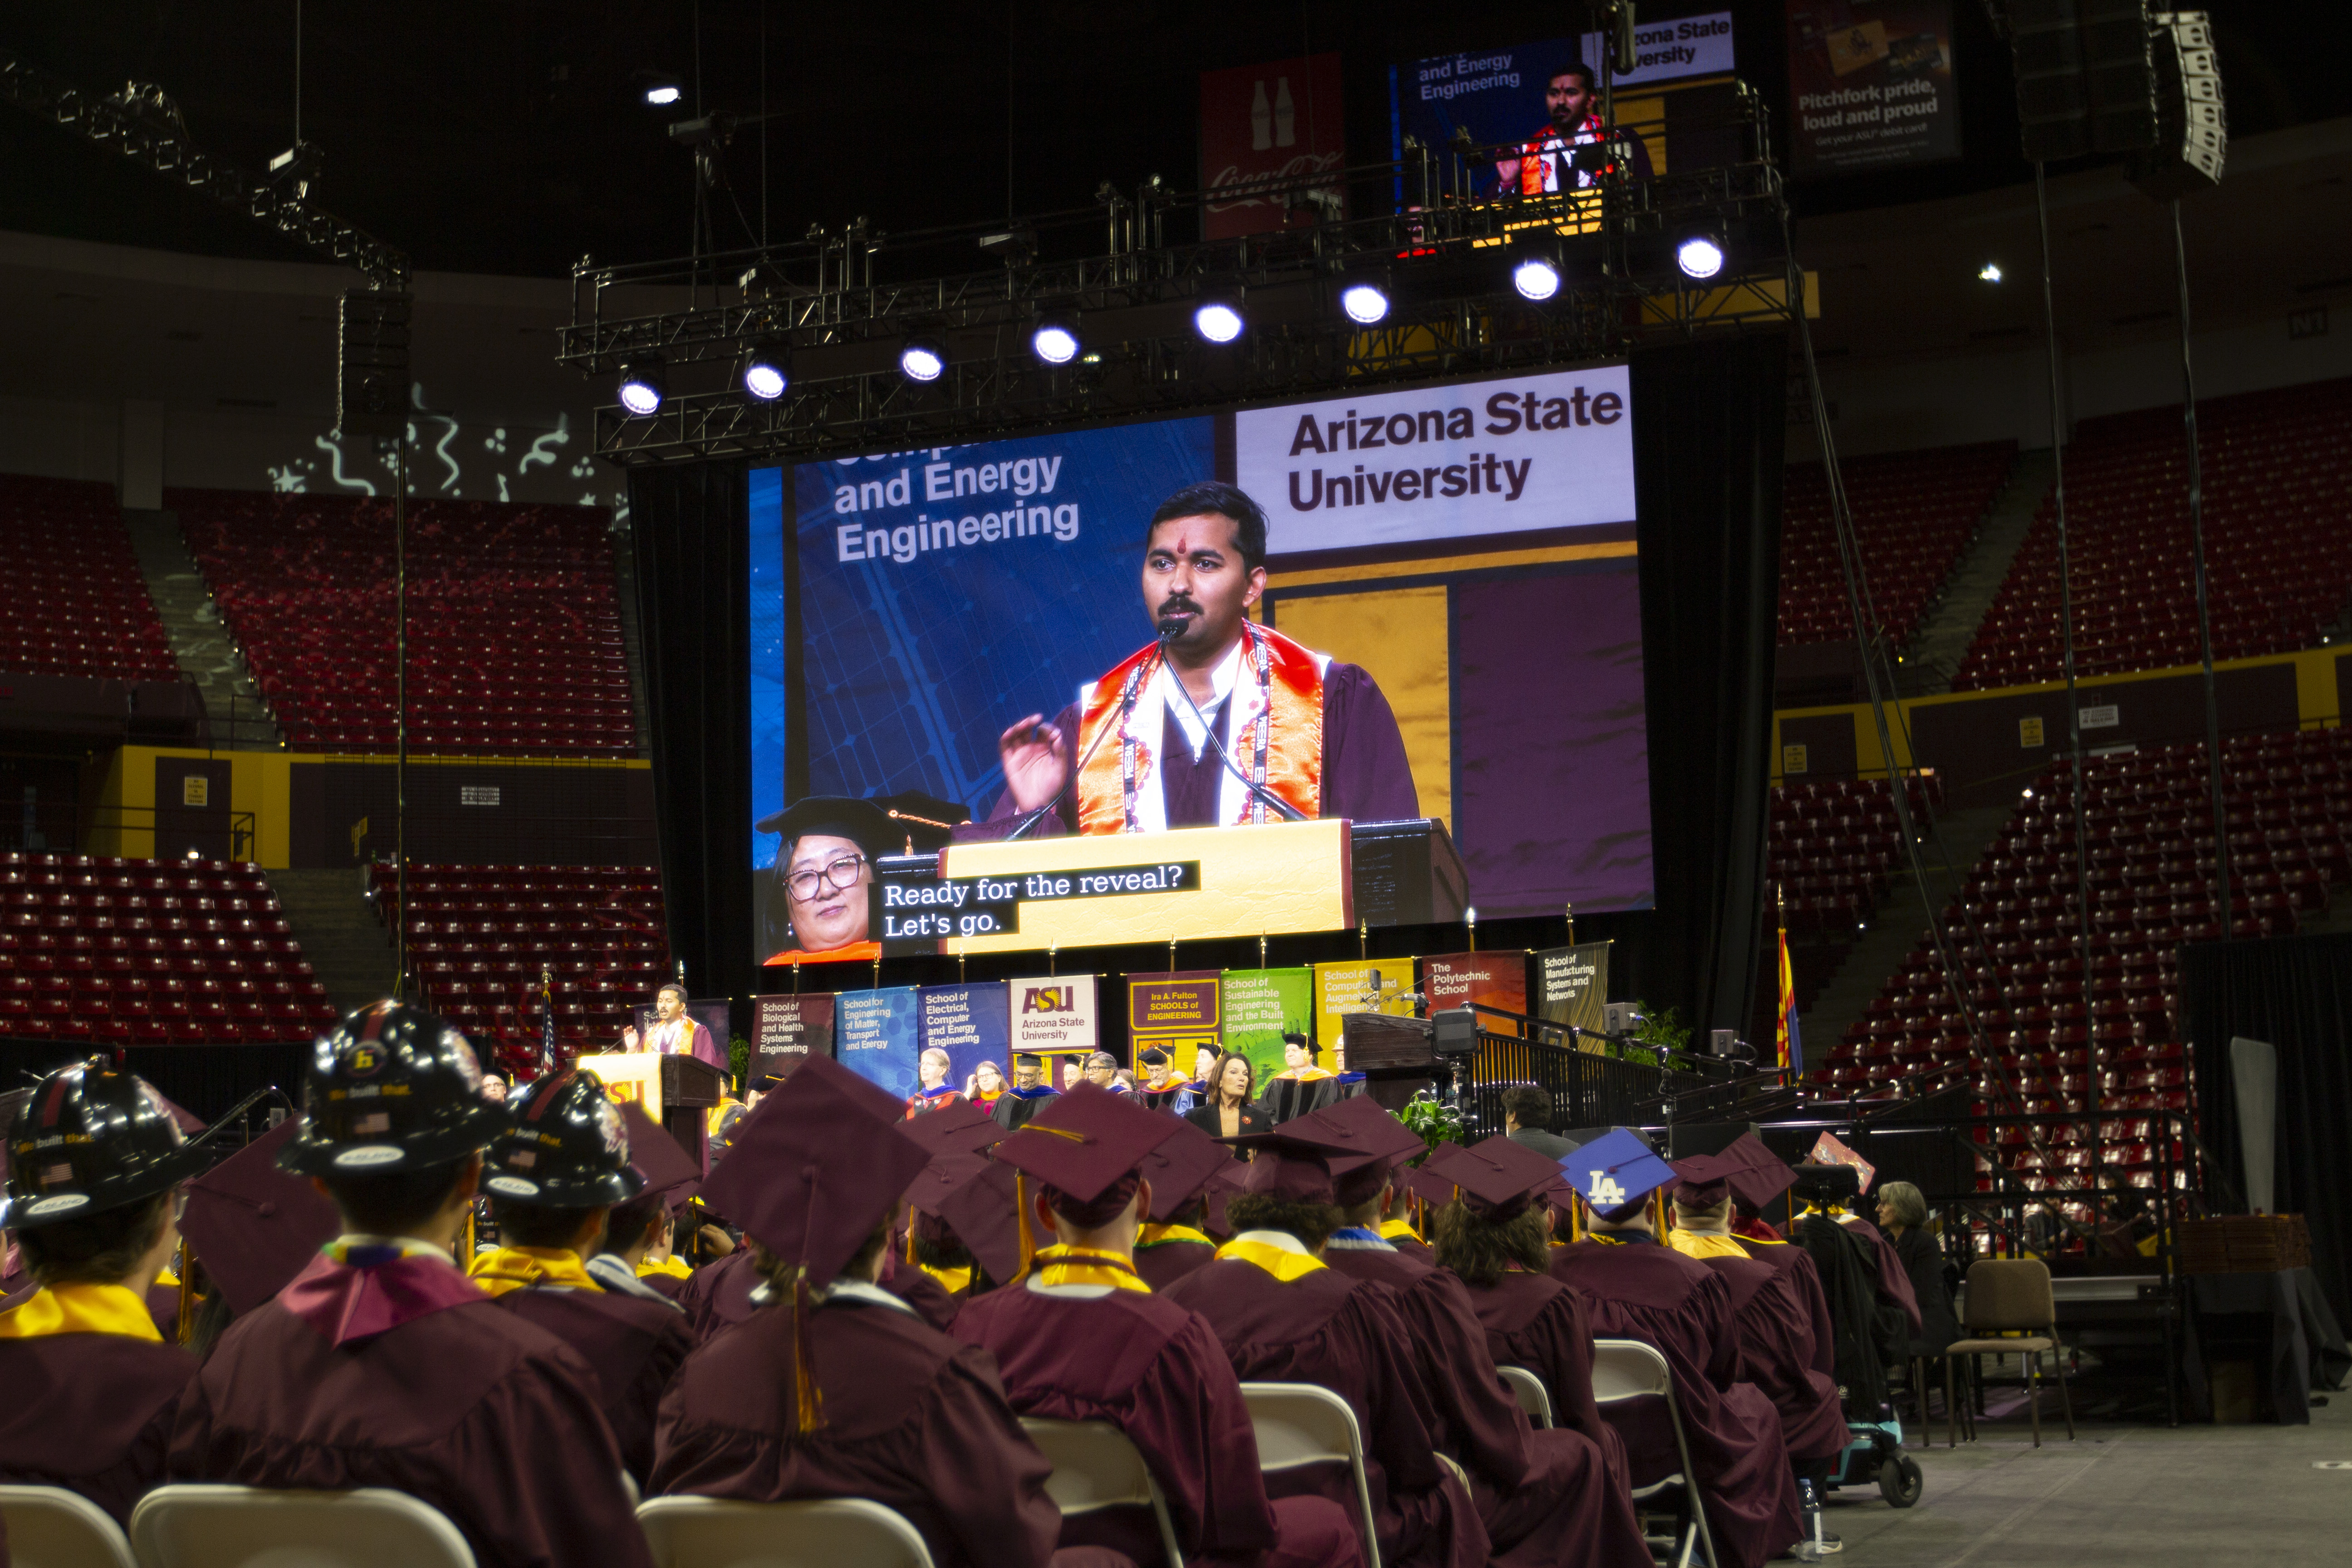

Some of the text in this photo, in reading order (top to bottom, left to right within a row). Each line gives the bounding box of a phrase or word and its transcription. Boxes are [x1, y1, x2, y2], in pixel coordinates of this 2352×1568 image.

[1635, 20, 1730, 46] zona State
[1636, 46, 1695, 68] versity
[1419, 62, 1451, 82] and
[1456, 54, 1513, 74] Energy
[1421, 72, 1520, 100] Engineering
[1798, 78, 1936, 111] Pitchfork pride,
[1803, 97, 1938, 131] loud and proud
[1289, 386, 1623, 456] Arizona State
[834, 456, 1062, 514] and Energy
[1289, 453, 1533, 512] University
[837, 500, 1079, 563] Engineering
[885, 865, 1183, 908] Ready for the reveal?
[885, 913, 1001, 937] Let's go.
[1544, 954, 1577, 968] School of
[1432, 963, 1450, 973] The
[1546, 965, 1595, 979] Manufacturing
[1324, 969, 1368, 980] School of
[1433, 971, 1490, 984] Polytechnic
[1224, 978, 1268, 990] School of
[1434, 983, 1468, 995] School
[1546, 975, 1588, 991] Systems and
[926, 991, 969, 1004] School of
[1022, 986, 1075, 1014] ASU
[1225, 989, 1279, 1000] Sustainable
[1547, 989, 1575, 1002] Networks
[763, 1002, 799, 1012] School of
[843, 997, 883, 1009] School for
[926, 1002, 969, 1015] Electrical,
[1150, 1002, 1188, 1010] SCHOOLS
[1225, 1000, 1280, 1012] Engineering
[763, 1012, 800, 1023] Biological
[844, 1008, 891, 1020] Engineering
[927, 1013, 970, 1025] Computer
[1147, 1012, 1201, 1020] ENGINEERING
[1226, 1010, 1284, 1021] and the Built
[762, 1023, 804, 1033] and Health
[845, 1019, 880, 1029] of Matter,
[1022, 1017, 1085, 1029] Arizona State
[1226, 1021, 1284, 1033] Environment
[845, 1029, 879, 1040] Transport
[928, 1024, 976, 1036] and Energy
[1022, 1030, 1068, 1040] University
[760, 1034, 793, 1044] Systems
[846, 1039, 888, 1050] and Energy
[928, 1034, 980, 1047] Engineering
[760, 1043, 808, 1055] Engineering
[36, 1134, 64, 1148] built
[1588, 1171, 1625, 1204] LA
